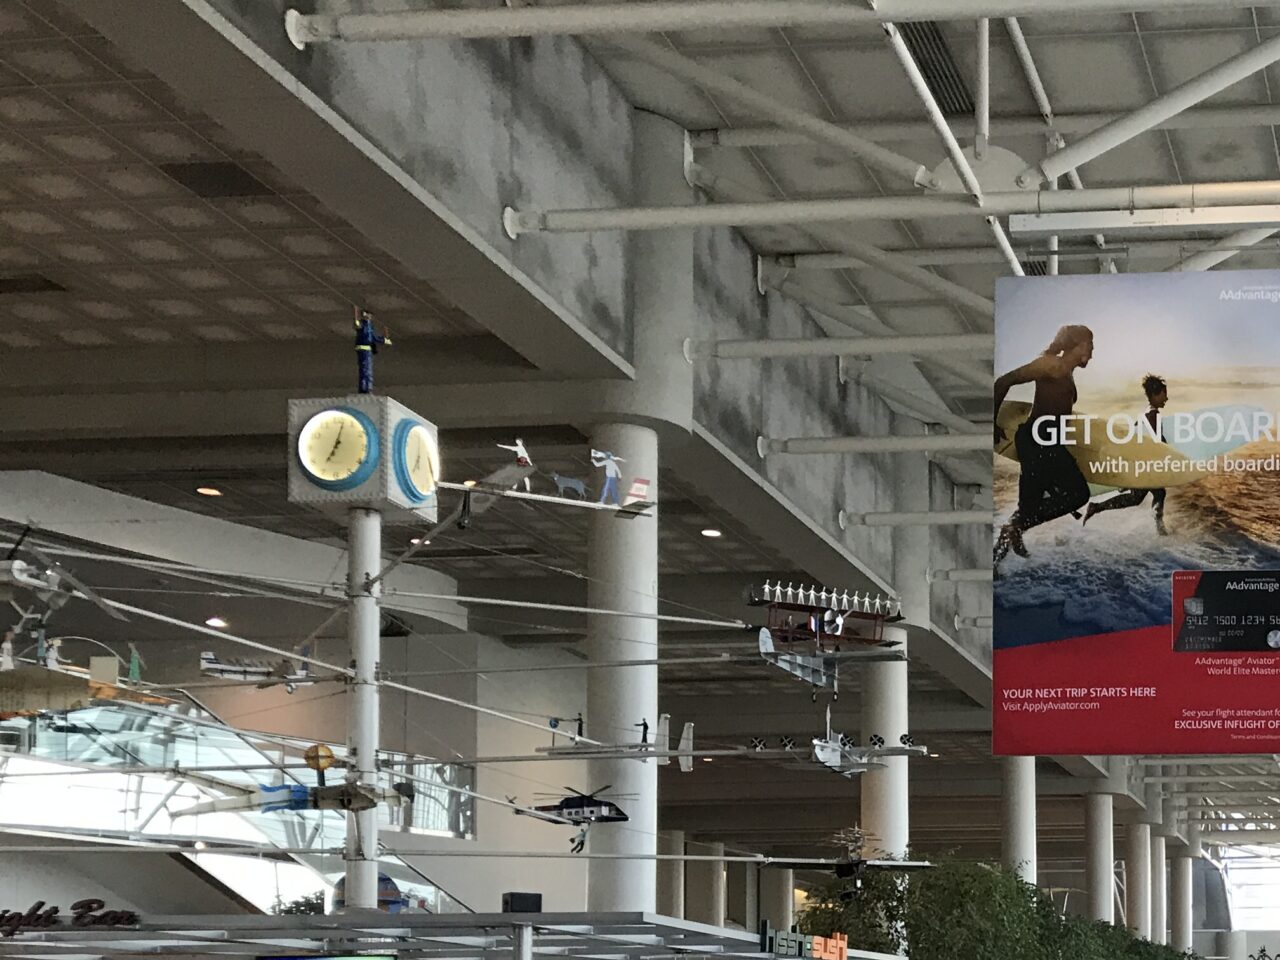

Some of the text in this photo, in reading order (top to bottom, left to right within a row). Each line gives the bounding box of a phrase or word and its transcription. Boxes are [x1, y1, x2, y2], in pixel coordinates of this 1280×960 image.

[1032, 413, 1098, 446] GET
[1106, 412, 1163, 444] ON
[1089, 456, 1128, 474] with
[1135, 454, 1217, 477] preferred
[1226, 580, 1280, 592] AAdvantage
[1186, 615, 1209, 625] 5412
[1213, 615, 1236, 625] 7500
[1241, 615, 1265, 625] 1234
[1207, 666, 1231, 675] World
[1233, 666, 1250, 675] Elite
[1003, 686, 1157, 699] YOUR NEXT TRIP STARTS HERE
[1002, 701, 1100, 713] Visit ApplyAviator.com
[1182, 708, 1196, 717] See
[1197, 710, 1214, 719] your
[1216, 708, 1235, 718] flight
[1236, 708, 1273, 717] attendant
[1174, 720, 1222, 729] EXCLUSIVE
[1224, 720, 1266, 729] INFLIGHT
